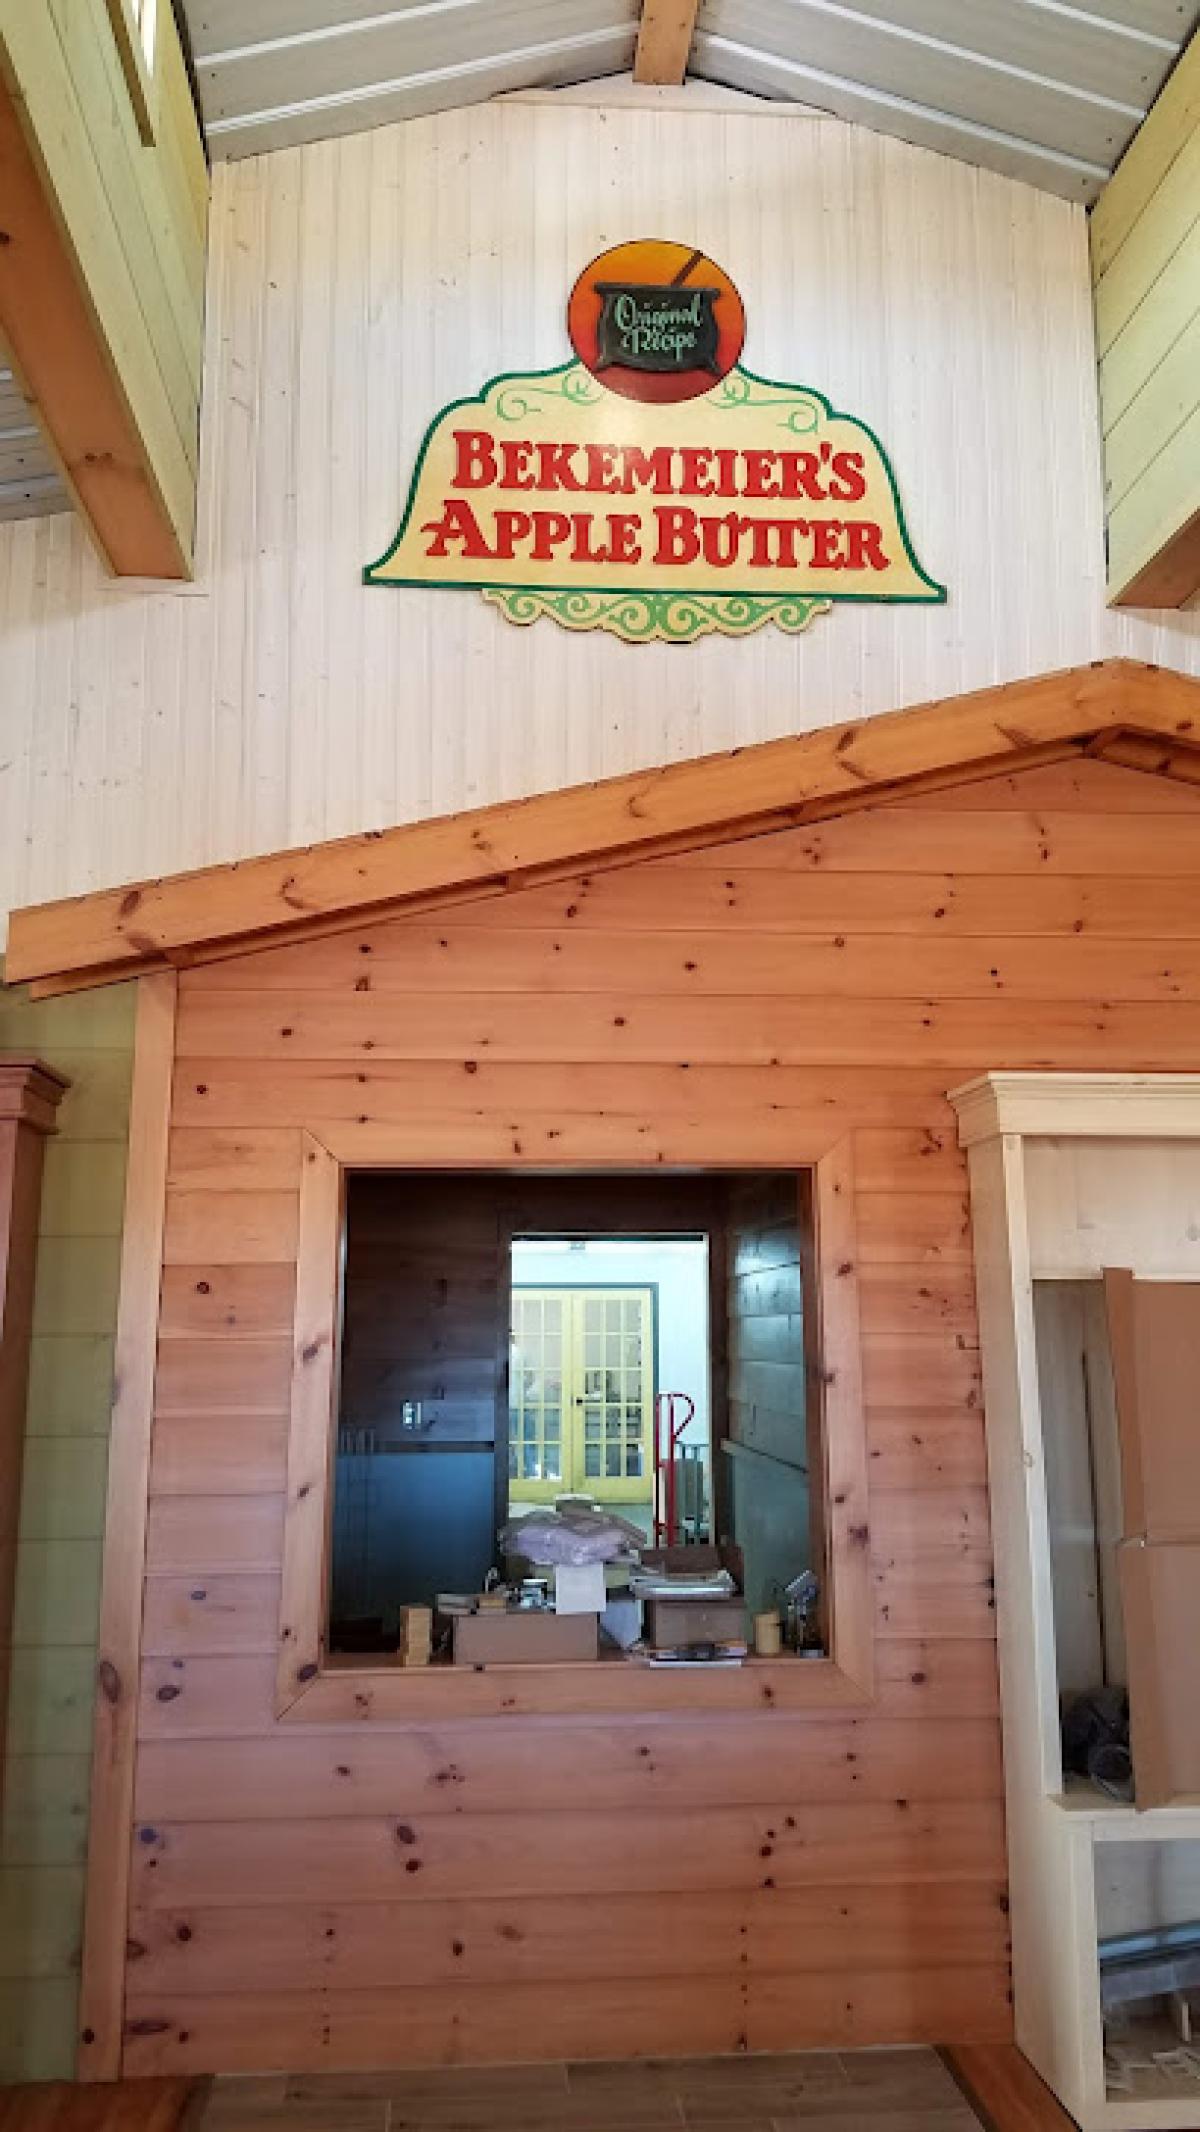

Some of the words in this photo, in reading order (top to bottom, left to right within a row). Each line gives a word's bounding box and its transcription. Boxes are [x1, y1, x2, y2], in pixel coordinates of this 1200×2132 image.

[614, 293, 702, 333] Original
[620, 326, 698, 361] Recipe
[451, 430, 865, 502] BEKEMEIER'S
[420, 499, 642, 563] APPLE
[652, 505, 891, 570] BUTTER
